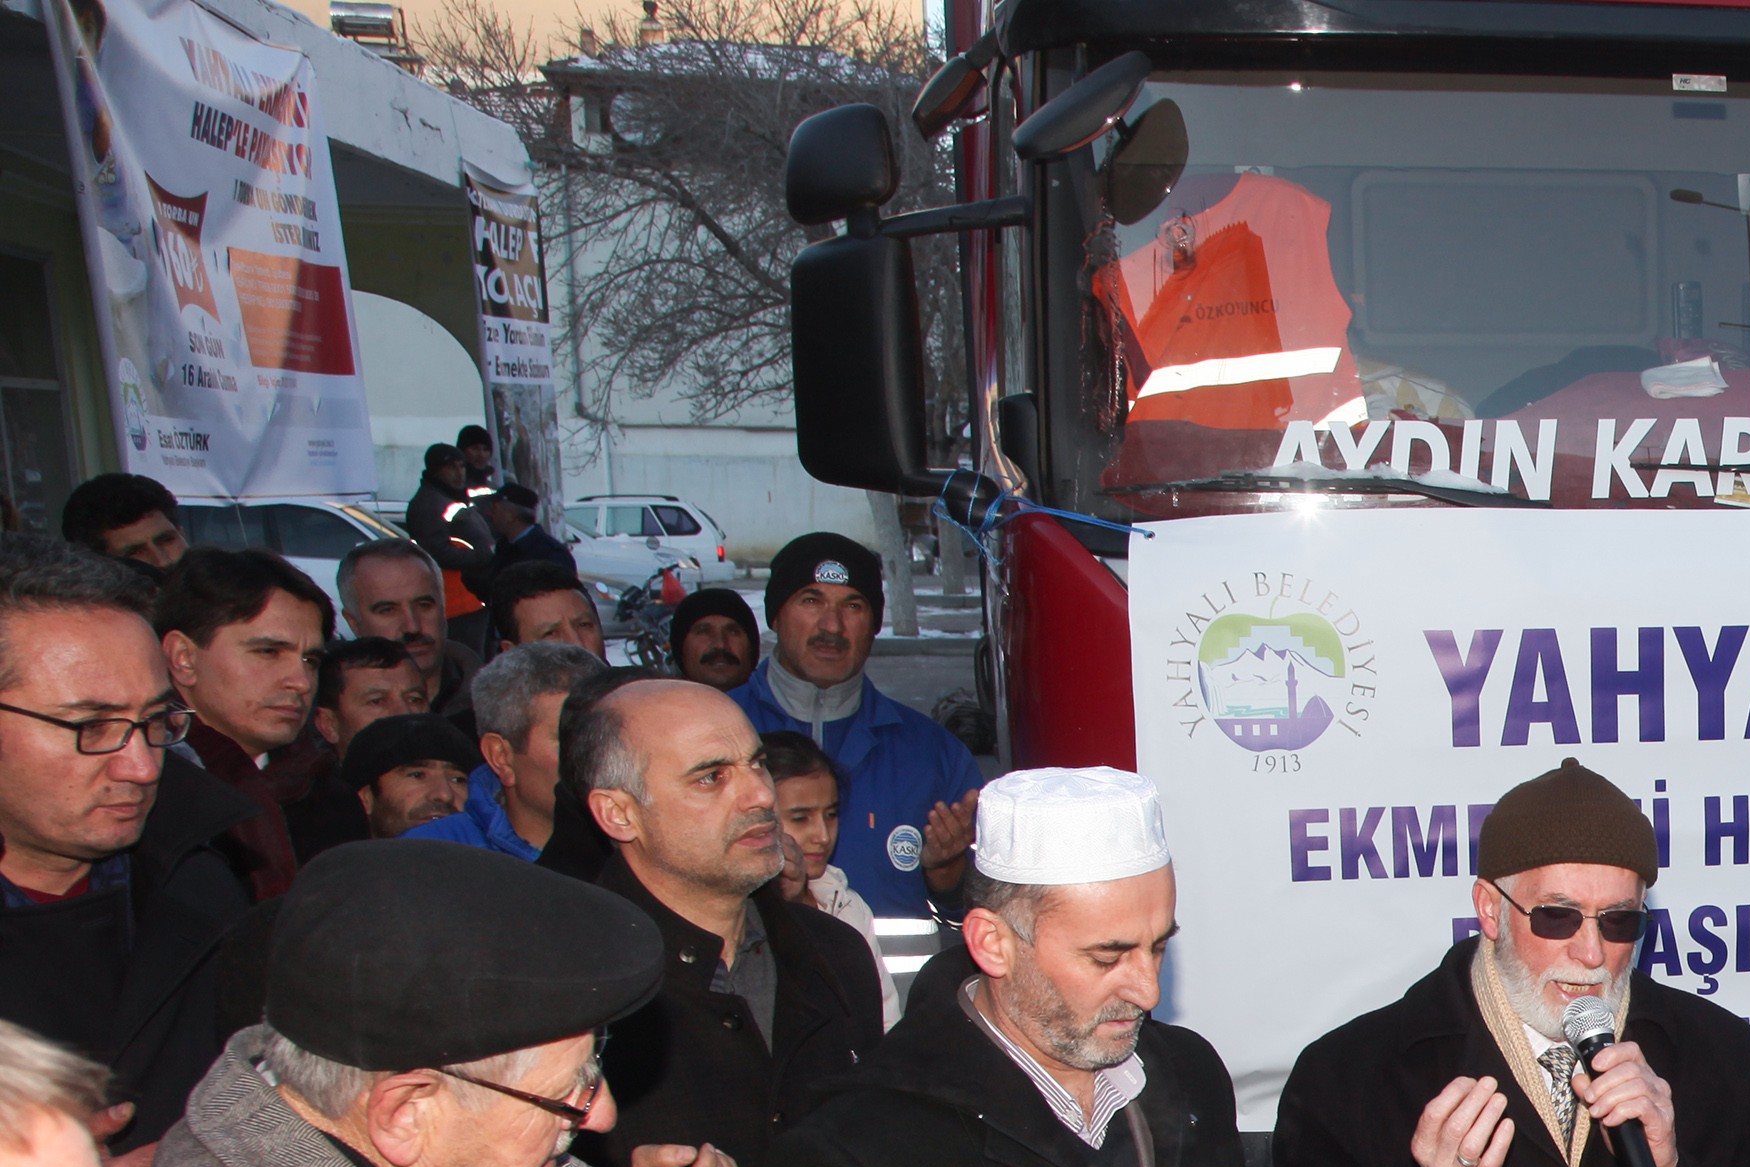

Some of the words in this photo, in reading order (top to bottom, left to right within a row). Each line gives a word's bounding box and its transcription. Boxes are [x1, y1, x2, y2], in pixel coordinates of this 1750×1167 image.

[182, 363, 194, 387] 16
[173, 427, 209, 451] ÖZTÜRK
[1266, 418, 1558, 500] AYDIN
[1167, 580, 1238, 739] YAHYALI
[1253, 571, 1378, 738] BELEDİYESİ
[1251, 753, 1302, 774] 1913
[1289, 780, 1670, 883] EKMİ
